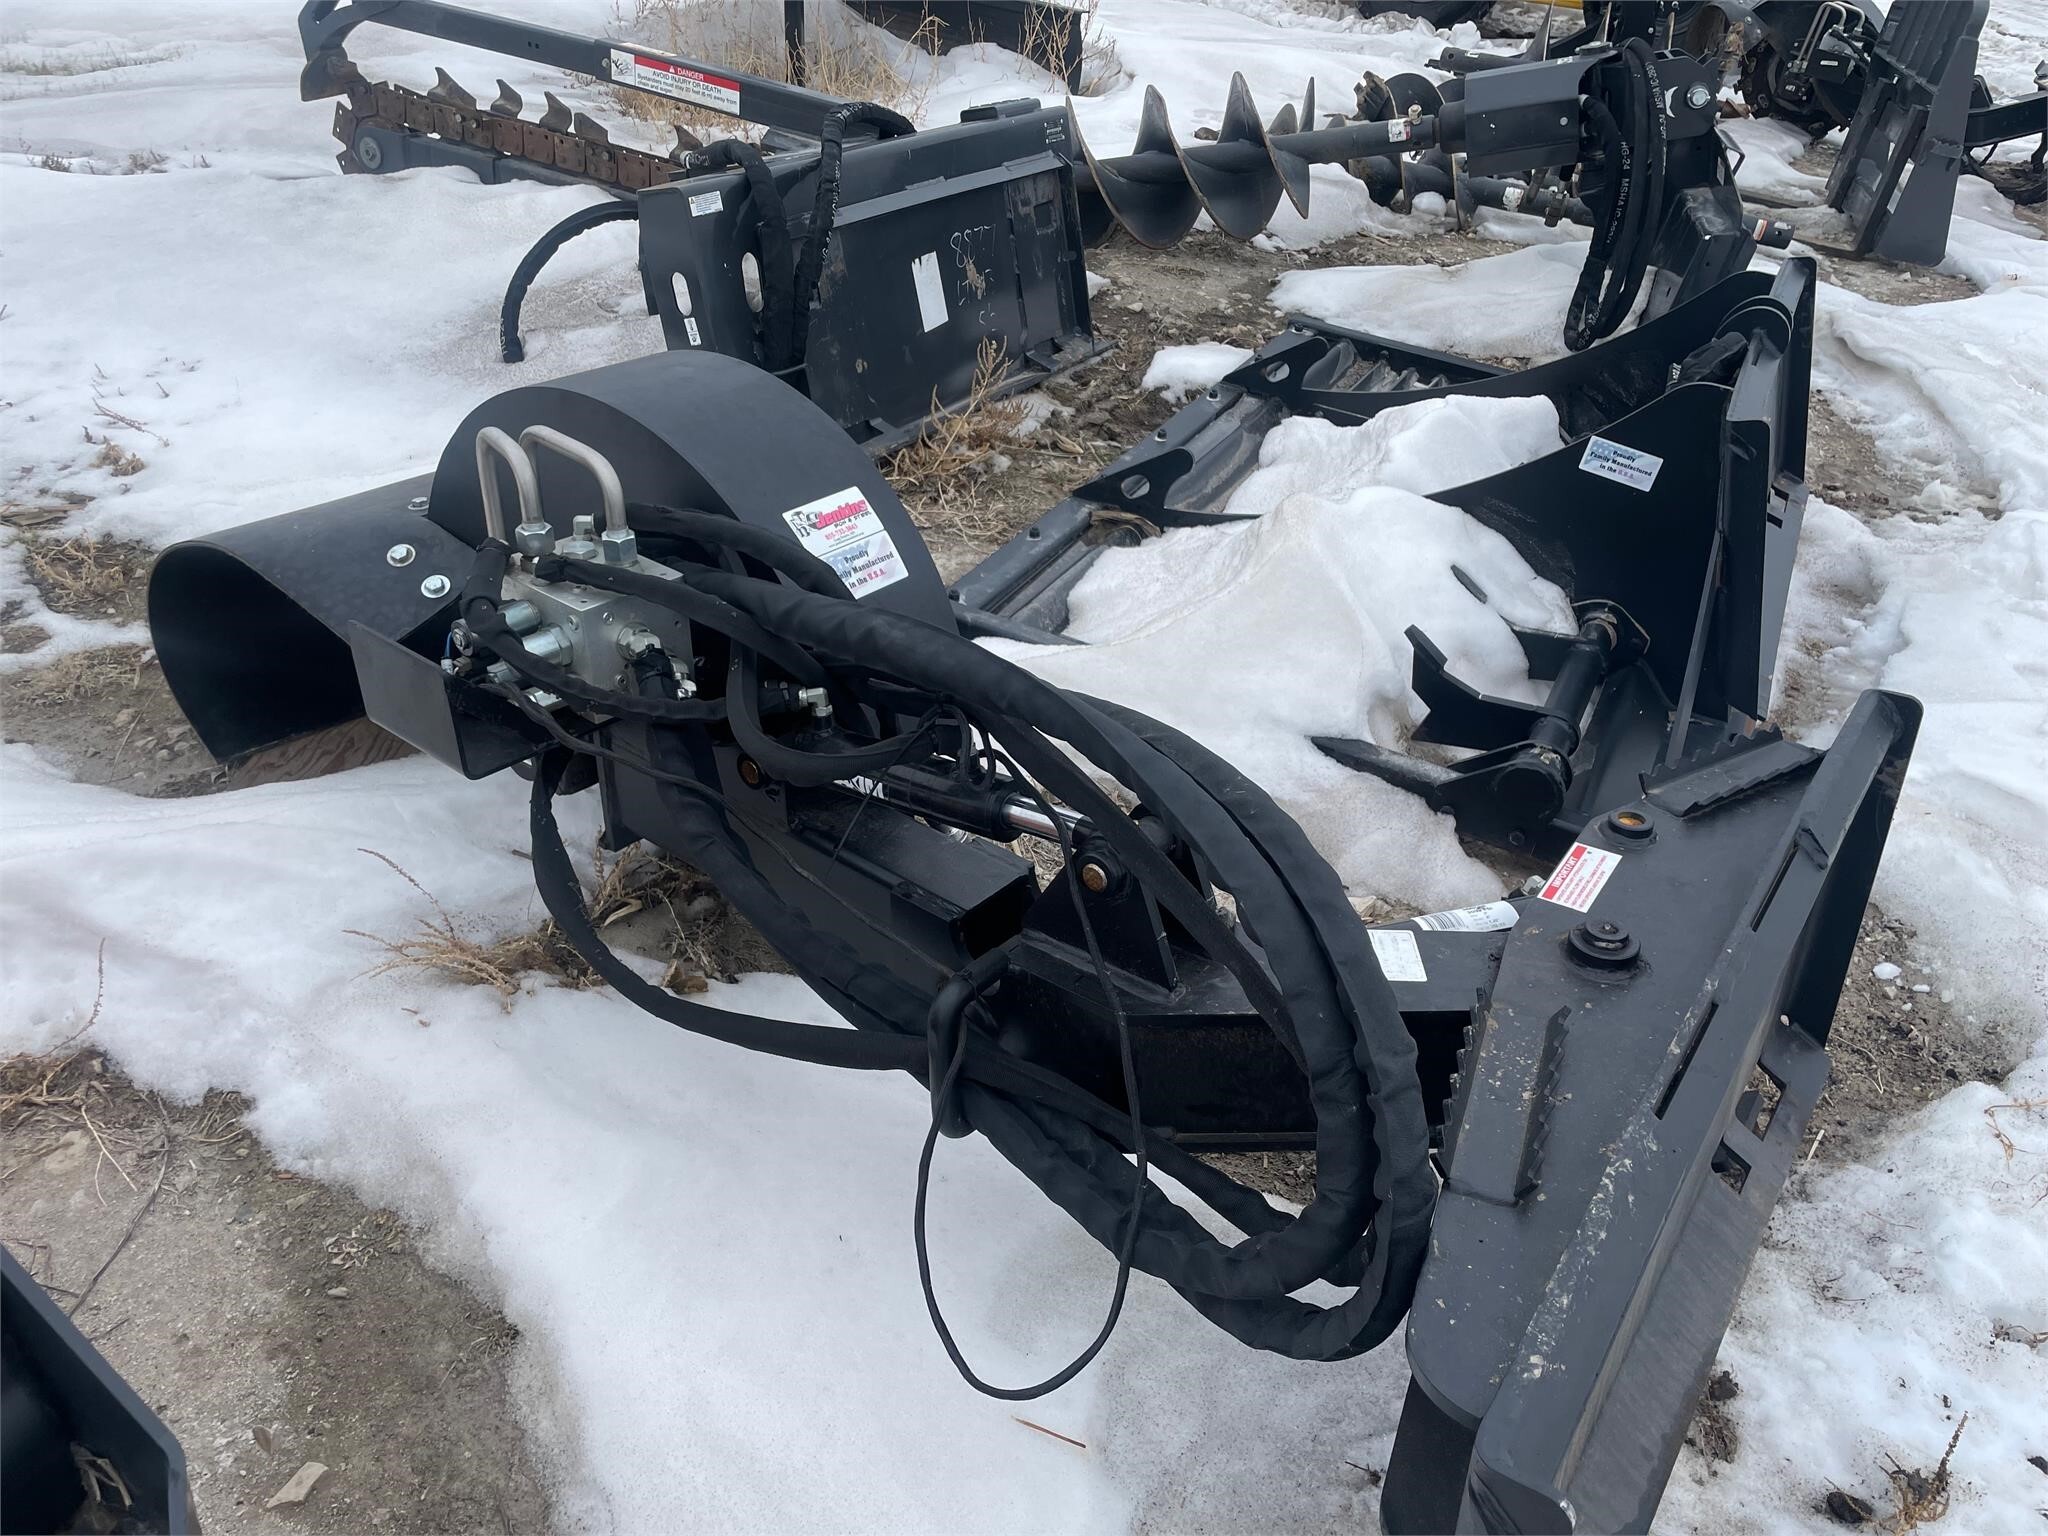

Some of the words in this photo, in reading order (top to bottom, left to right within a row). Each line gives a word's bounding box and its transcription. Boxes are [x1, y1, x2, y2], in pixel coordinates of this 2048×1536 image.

[652, 70, 670, 80] AVOID
[670, 74, 691, 87] INJURY
[692, 80, 701, 89] OR
[702, 83, 722, 95] DEATH
[677, 67, 704, 81] DANGER
[726, 97, 737, 105] from
[1620, 141, 1631, 170] HG-24
[1616, 178, 1630, 206] MSHA
[1590, 451, 1610, 463] Family
[1611, 458, 1653, 477] Manufactured
[1607, 465, 1617, 473] the
[1613, 450, 1636, 463] Proudly
[816, 499, 868, 530] Jenkins
[844, 549, 869, 565] Proudly
[851, 551, 894, 576] Manufactured
[857, 575, 868, 586] the
[1550, 856, 1578, 889] IMPORTANT
